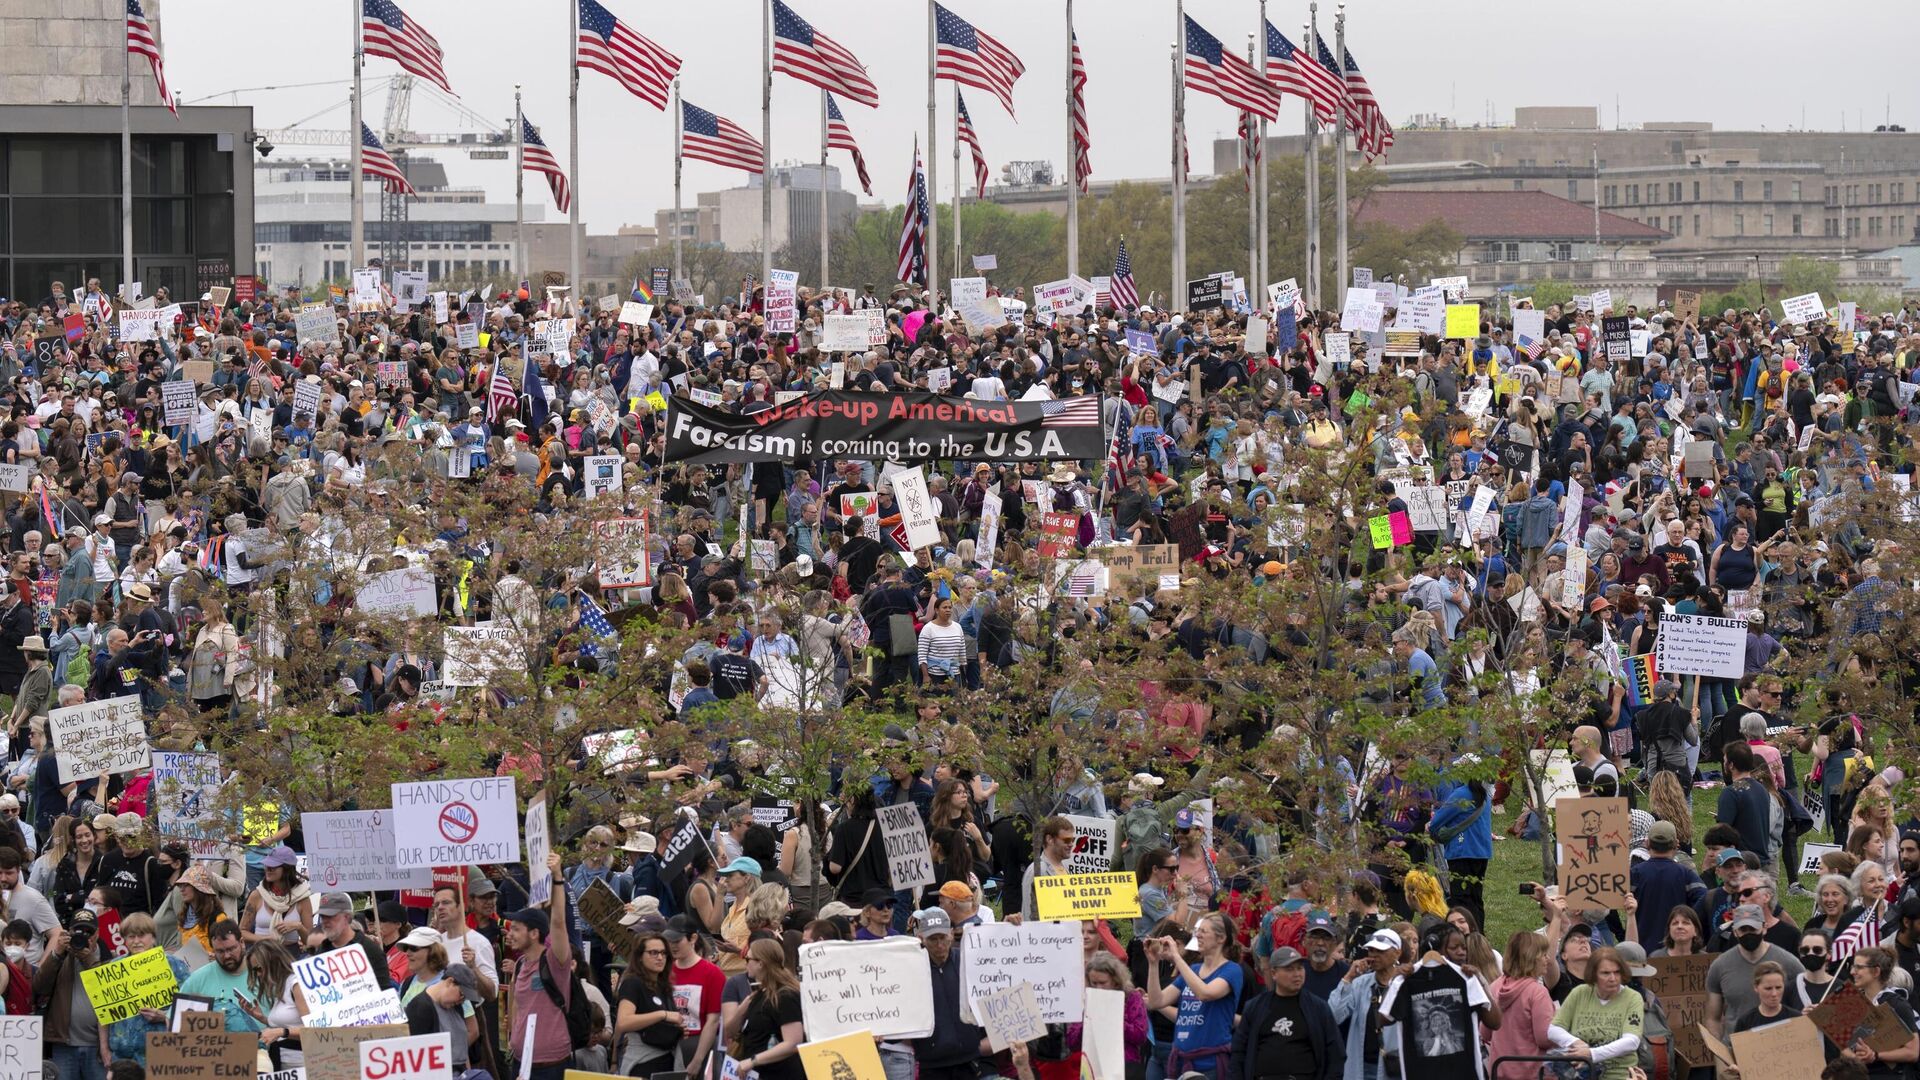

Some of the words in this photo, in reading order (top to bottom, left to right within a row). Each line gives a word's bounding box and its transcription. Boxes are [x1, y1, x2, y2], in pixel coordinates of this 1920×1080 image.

[1203, 279, 1219, 288] MUST
[1277, 283, 1290, 293] NO
[1678, 290, 1697, 298] HANDS
[1052, 300, 1064, 310] FIRE
[121, 311, 149, 321] HANDS
[149, 310, 165, 320] OFF
[1804, 312, 1824, 321] STUFF
[1606, 320, 1625, 330] 8647
[1609, 331, 1625, 340] MUSK
[527, 345, 547, 353] OFF!
[1611, 346, 1627, 354] OFF!
[379, 362, 407, 371] RESIST
[166, 392, 193, 401] HANDS
[297, 392, 318, 404] HANDS
[168, 400, 195, 410] OFF!
[295, 400, 316, 413] OFF!
[752, 398, 878, 427] Wake-up
[887, 395, 1017, 426] America!
[672, 412, 796, 457] Fascism
[801, 434, 812, 456] is
[820, 433, 900, 460] coming
[908, 437, 932, 457] to
[940, 432, 974, 457] the
[983, 429, 1070, 458] U.S.A.
[592, 458, 619, 466] GROUPER
[590, 478, 614, 486] GROPER
[901, 475, 919, 489] NOT
[909, 517, 933, 530] PRESIDENT
[912, 512, 924, 521] MY
[1046, 516, 1062, 526] SAVE
[1063, 518, 1077, 529] OUR
[1135, 546, 1174, 565] Trail
[375, 593, 417, 604] SCIENCE
[1660, 614, 1692, 627] ELON'S
[1696, 617, 1704, 626] 5
[1707, 617, 1748, 629] BULLETS
[1687, 628, 1700, 636] Tesla
[1659, 633, 1665, 642] 2
[1695, 637, 1712, 646] Federal
[1713, 640, 1737, 649] Employees
[1659, 643, 1665, 652] 3
[1710, 649, 1731, 657] progress
[1657, 653, 1665, 662] 4
[1658, 663, 1665, 672] 5
[1670, 664, 1689, 673] Kissed
[1633, 655, 1652, 700] RESIST
[422, 680, 444, 694] Stand
[445, 683, 455, 693] up
[55, 710, 86, 730] WHEN
[60, 727, 100, 747] BECOMES
[104, 720, 129, 735] LAW
[1765, 725, 1789, 736] RESIST
[72, 760, 112, 777] BECOMES
[118, 749, 146, 767] DUTY
[164, 753, 206, 769] PROTECT
[399, 783, 465, 805] HANDS
[470, 778, 511, 801] OFF
[1803, 796, 1823, 818] OFF!
[326, 817, 363, 828] PROCLAIM
[885, 805, 915, 830] BRING
[315, 828, 396, 850] LIBERTY
[1075, 826, 1108, 838] HANDS
[885, 830, 929, 858] DEMOCRACY
[1072, 836, 1108, 856] OFF
[310, 853, 357, 868] Throughout
[359, 853, 373, 866] all
[376, 854, 387, 866] the
[398, 847, 423, 866] OUR
[429, 842, 510, 863] DEMOCRACY!
[1073, 855, 1111, 869] CANCER
[309, 872, 325, 883] unto
[348, 868, 381, 882] inhabitants
[384, 867, 411, 881] thereof
[897, 858, 925, 884] BACK
[1039, 878, 1066, 888] FULL
[1069, 874, 1133, 887] CEASEFIRE
[1565, 873, 1628, 895] LOSER
[1063, 889, 1077, 898] IN
[1080, 887, 1112, 898] GAZA
[1071, 899, 1107, 910] NOW!
[927, 917, 943, 926] DC
[969, 932, 982, 950] It
[988, 934, 998, 948] is
[1001, 932, 1022, 948] evil
[1027, 934, 1039, 947] to
[1040, 935, 1076, 950] conquer
[807, 947, 827, 960] Evil
[976, 955, 996, 967] some
[1001, 956, 1019, 966] one
[1023, 953, 1048, 965] elses
[95, 962, 130, 986] MAGA
[130, 951, 166, 971] (MAGGOTS)
[297, 949, 368, 991] USAID
[806, 963, 847, 983] Trump
[859, 964, 887, 981] says
[1666, 964, 1682, 974] the
[102, 981, 134, 1003] MUSK
[132, 969, 173, 990] (MUSKRATS)
[979, 971, 1013, 988] country
[1652, 978, 1669, 994] OF
[808, 989, 829, 1004] We
[840, 984, 863, 999] will
[870, 982, 901, 997] have
[971, 983, 992, 998] And
[1033, 981, 1044, 992] as
[1047, 978, 1066, 995] part
[1411, 993, 1424, 1001] NOT
[1423, 992, 1433, 1000] MY
[1433, 988, 1461, 998] PRESIDENT
[308, 993, 317, 1004] is
[319, 987, 344, 1006] both
[984, 990, 1026, 1015] WORST
[1180, 1001, 1203, 1012] OVER
[1667, 1001, 1682, 1011] the
[109, 1004, 128, 1023] NO
[837, 1006, 901, 1024] Greenland
[187, 1016, 219, 1032] YOU
[993, 1010, 1038, 1036] SEQUEL
[315, 1031, 344, 1046] Why
[1002, 1023, 1040, 1043] EVER
[195, 1034, 233, 1047] SPELL
[365, 1045, 446, 1080] SAVE
[151, 1063, 205, 1077] WITHOUT
